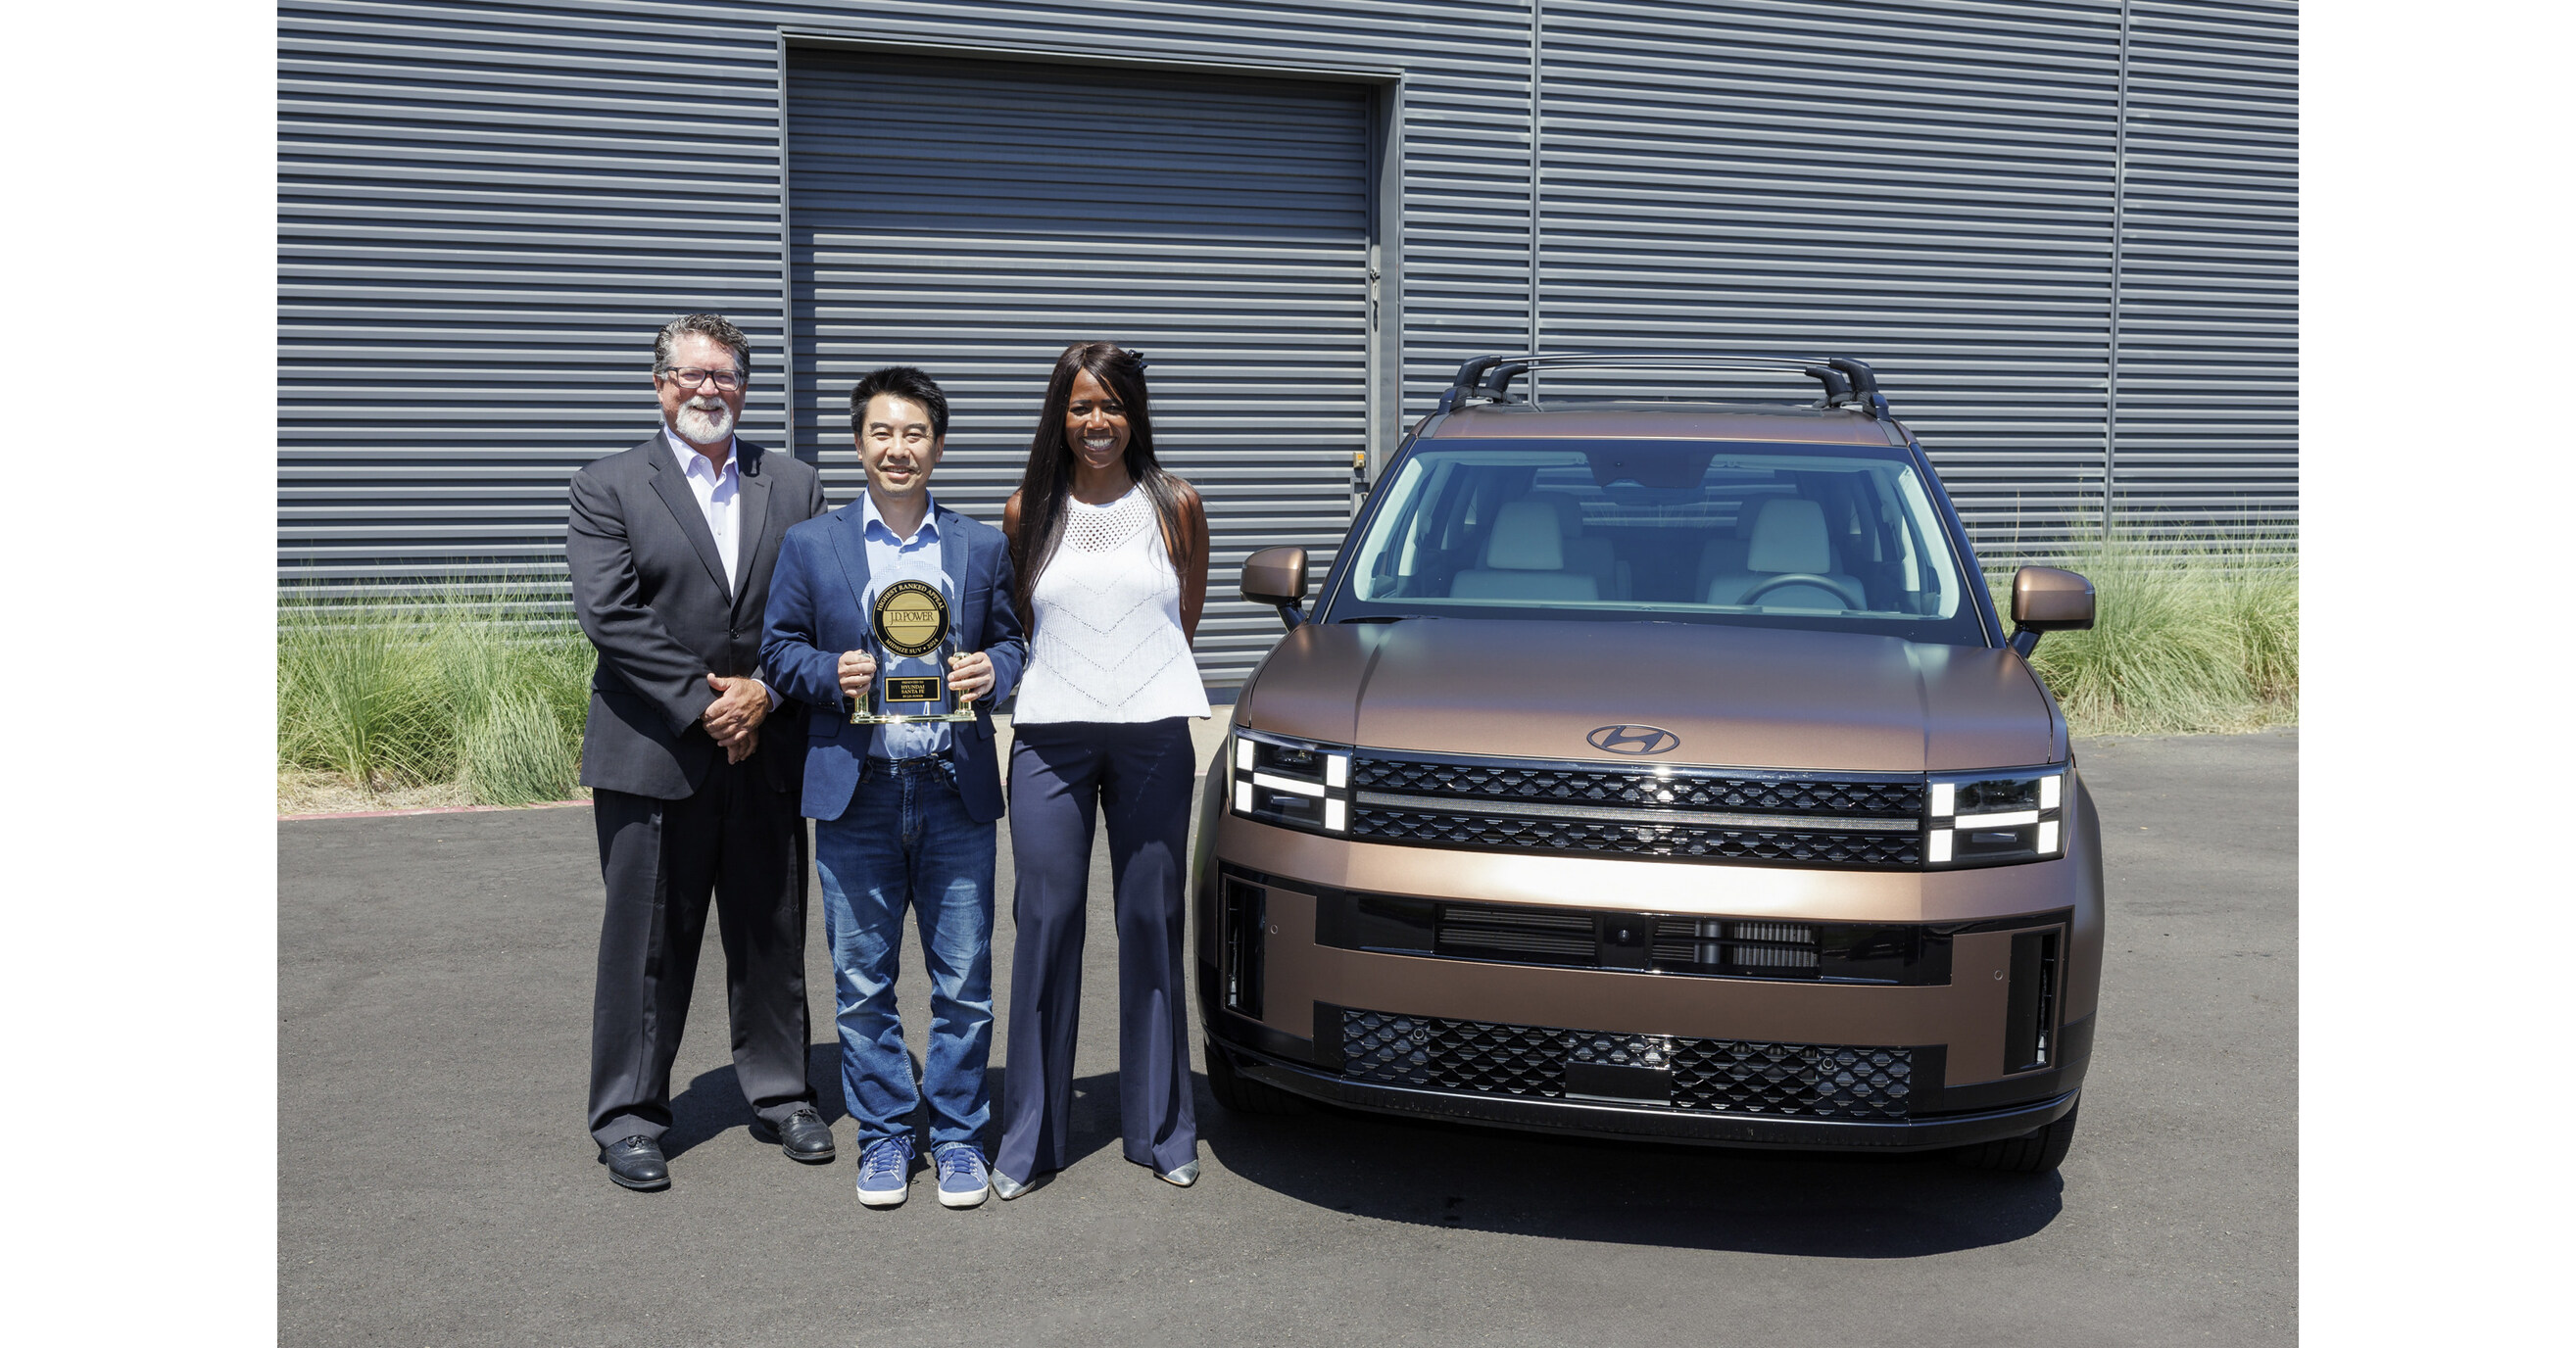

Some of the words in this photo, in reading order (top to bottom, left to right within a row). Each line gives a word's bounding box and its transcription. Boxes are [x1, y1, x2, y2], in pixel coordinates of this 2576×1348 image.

[877, 587, 898, 611] HIGHEST
[898, 583, 927, 592] RANKED
[926, 589, 945, 611] APPEAL
[885, 638, 908, 653] MIDSIZE
[926, 638, 939, 650] 2024
